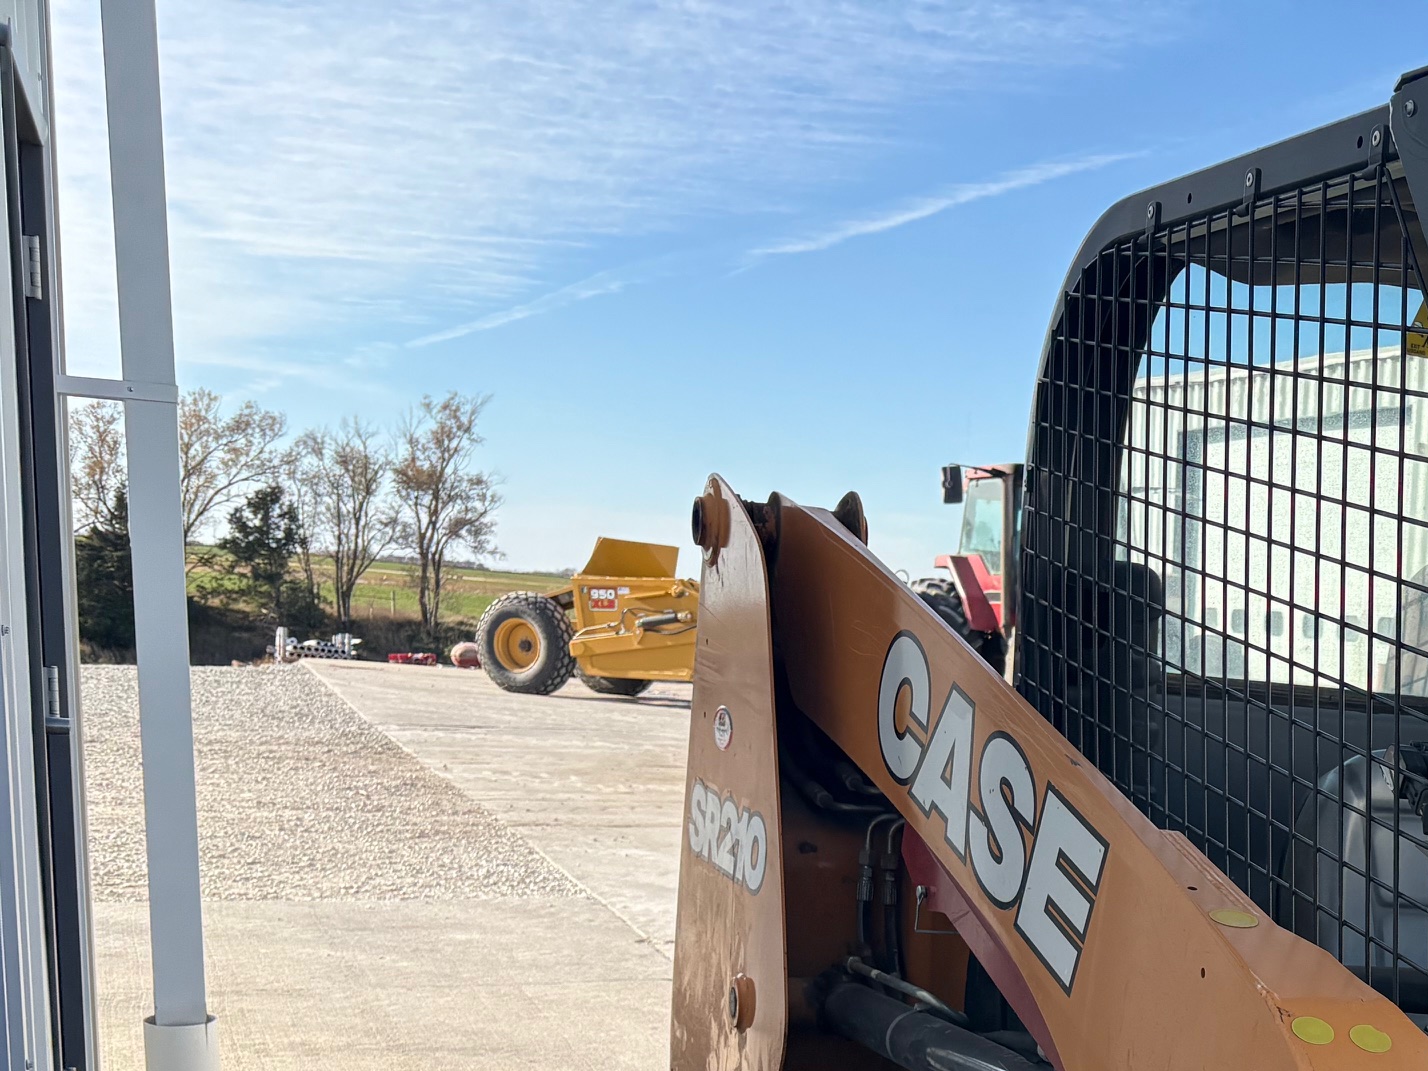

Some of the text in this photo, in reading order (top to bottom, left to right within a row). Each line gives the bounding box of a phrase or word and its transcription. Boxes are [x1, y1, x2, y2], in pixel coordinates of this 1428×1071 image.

[590, 588, 615, 599] 950
[688, 779, 767, 896] SR210
[878, 629, 1110, 998] CASE
